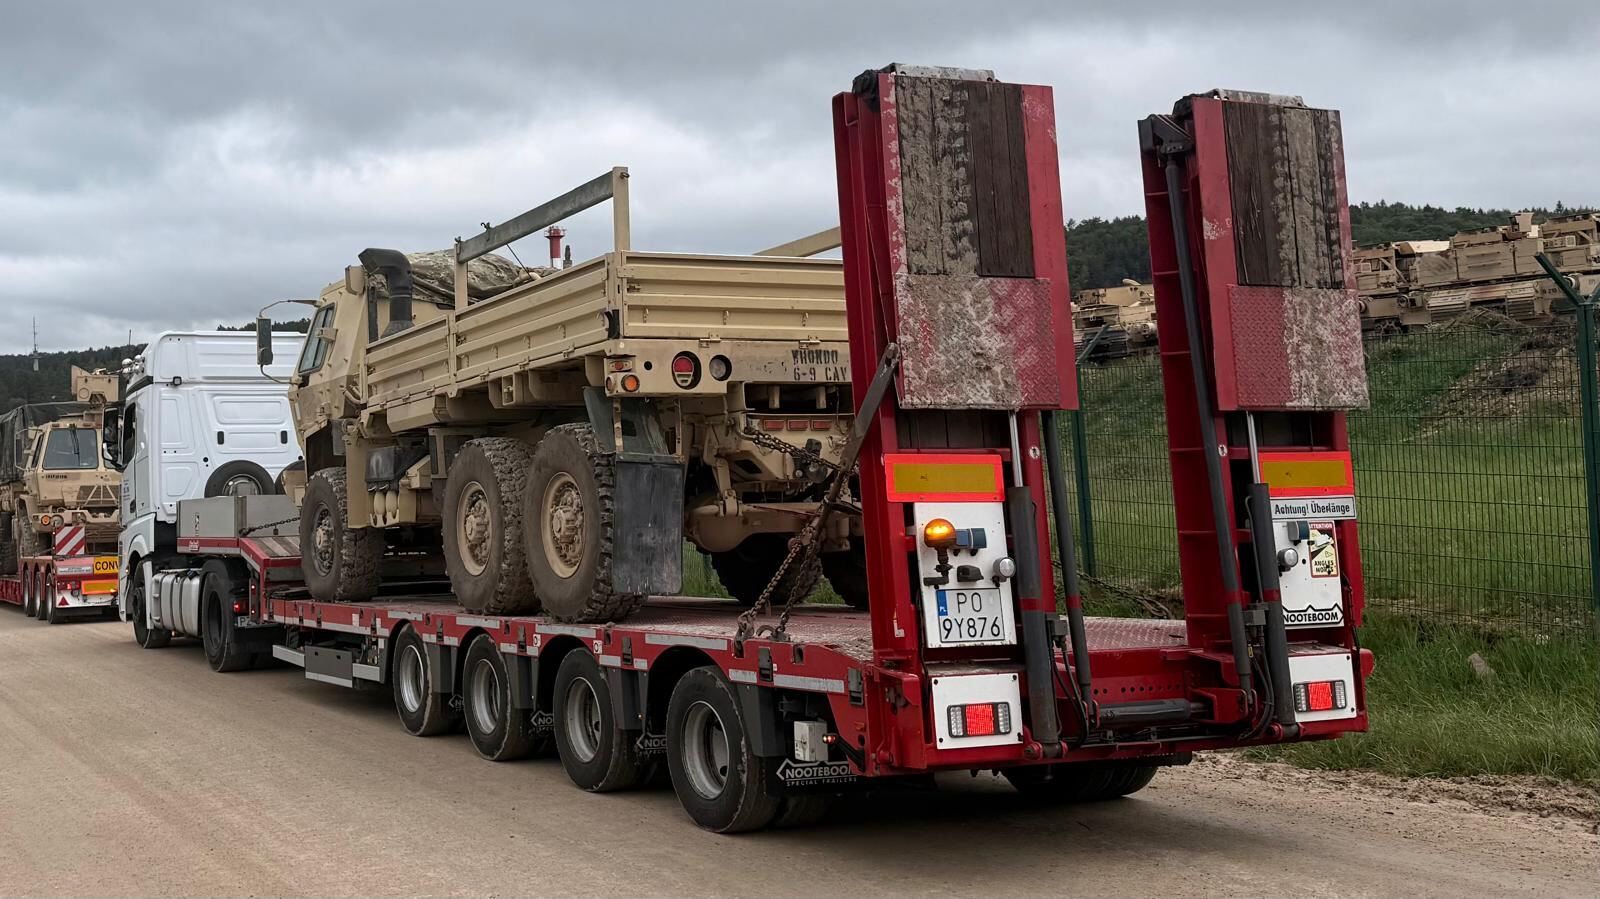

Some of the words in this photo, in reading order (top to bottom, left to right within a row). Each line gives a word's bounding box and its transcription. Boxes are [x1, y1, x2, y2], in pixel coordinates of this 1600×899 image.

[793, 367, 816, 381] 6-9
[825, 367, 847, 381] CAV
[1274, 503, 1309, 516] Achtung!
[1311, 501, 1350, 514] Überlänge
[956, 592, 982, 613] PO
[1283, 612, 1338, 623] NOOTEBOOM
[942, 616, 1000, 640] 9Y876
[785, 765, 851, 779] NOOTEBOO
